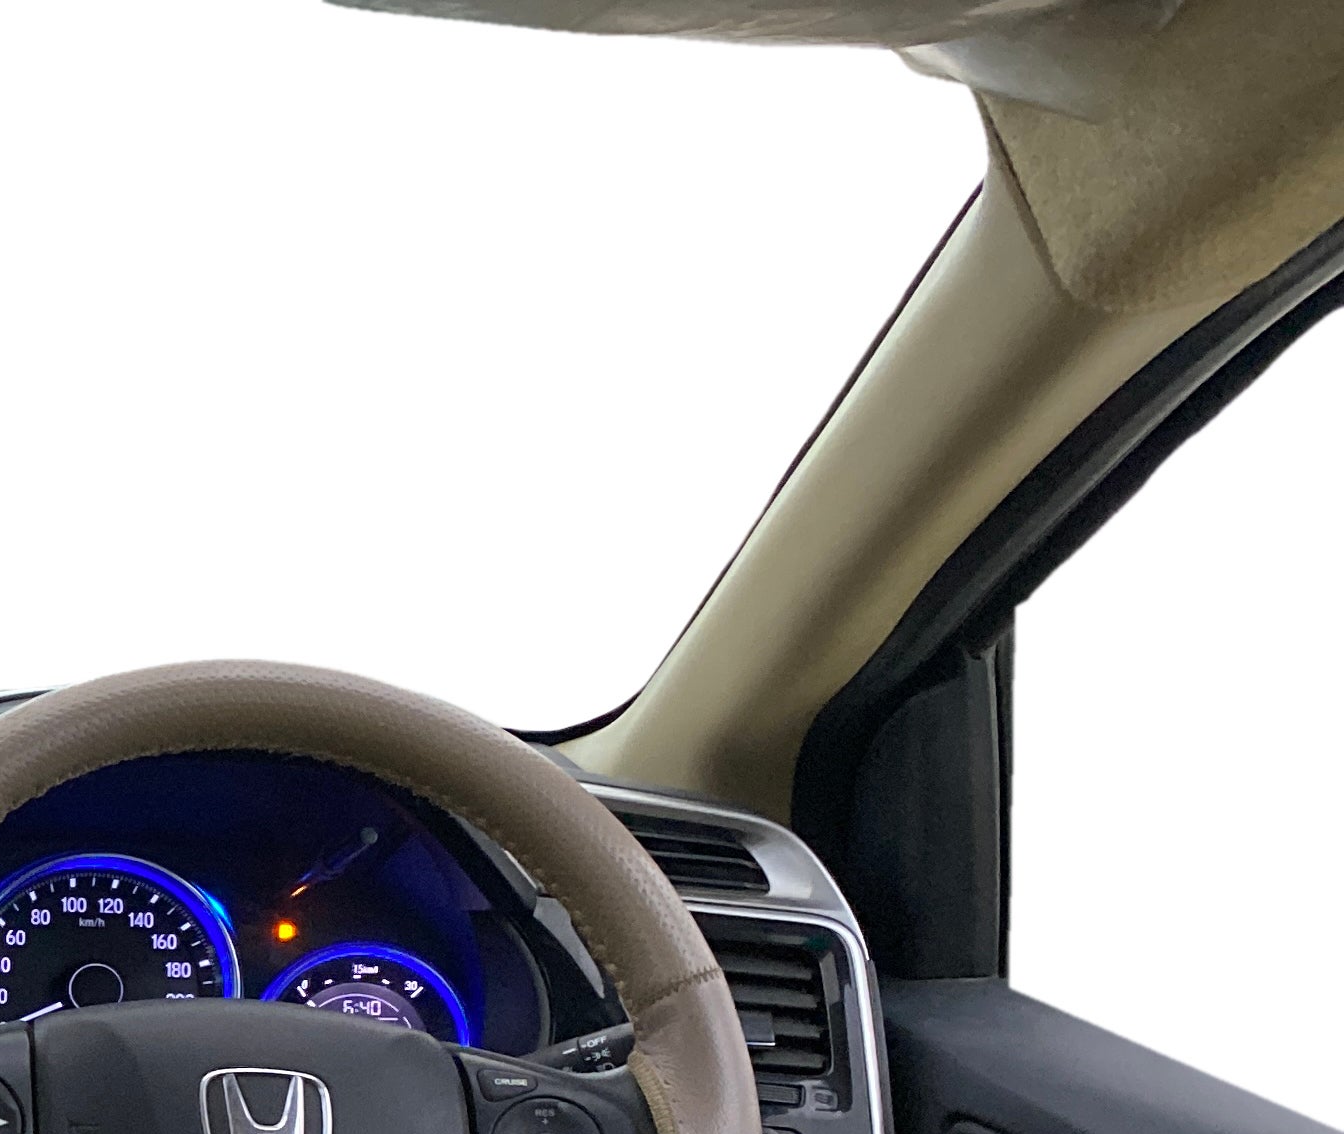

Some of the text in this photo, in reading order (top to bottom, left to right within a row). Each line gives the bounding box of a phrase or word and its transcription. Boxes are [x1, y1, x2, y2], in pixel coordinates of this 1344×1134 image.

[61, 897, 87, 913] 100
[97, 898, 124, 914] 120
[30, 909, 51, 926] 80
[78, 917, 105, 928] km/h
[128, 911, 154, 929] 140
[5, 930, 26, 946] 60
[151, 933, 178, 950] 160
[165, 961, 192, 978] 180
[404, 980, 418, 991] 30
[586, 1035, 608, 1048] OFF
[494, 1077, 528, 1087] CRUISE
